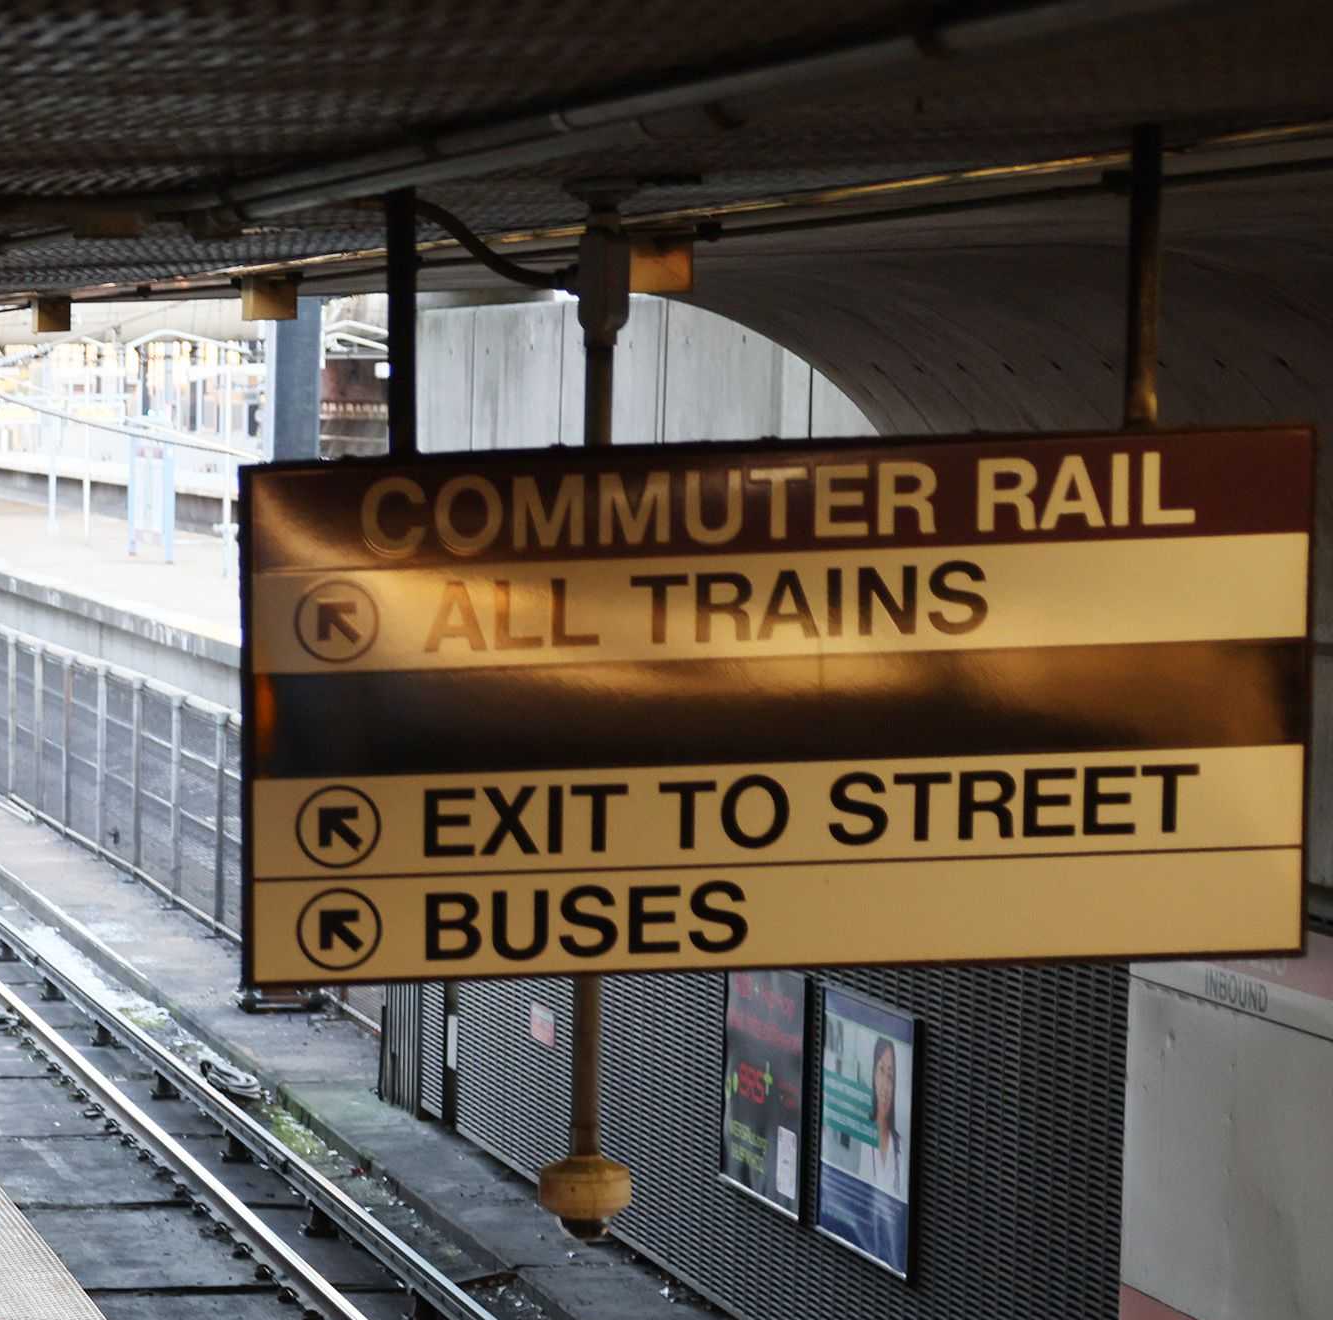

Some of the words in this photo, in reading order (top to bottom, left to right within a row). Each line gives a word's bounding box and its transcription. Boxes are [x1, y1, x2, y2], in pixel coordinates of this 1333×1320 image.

[360, 458, 940, 560] COMMUTER
[975, 449, 1197, 533] RAIL
[424, 577, 599, 654] ALL
[630, 559, 992, 645] TRAINS
[423, 783, 628, 858] EXIT
[660, 773, 790, 851] TO
[828, 763, 1202, 846] STREET
[424, 879, 749, 962] BUSES
[1204, 967, 1269, 1013] INBOUND
